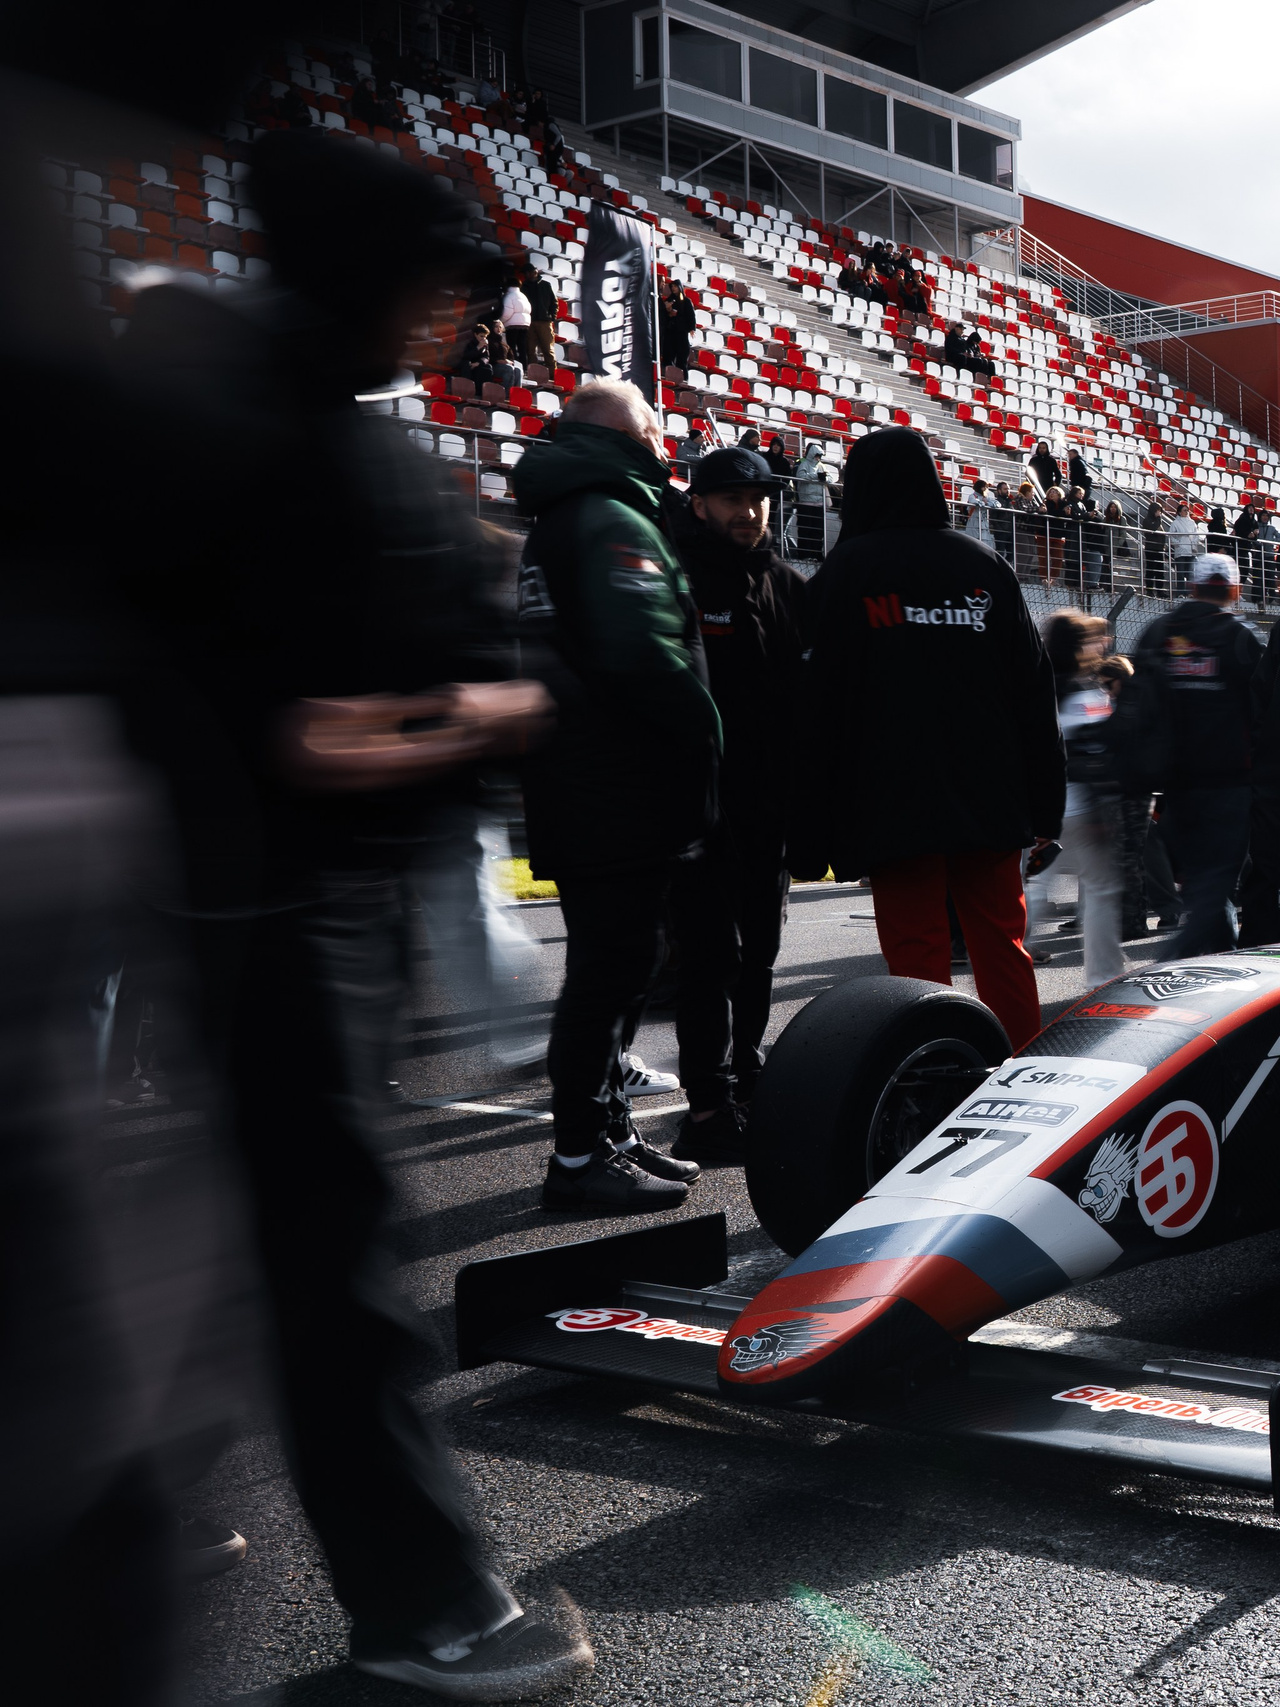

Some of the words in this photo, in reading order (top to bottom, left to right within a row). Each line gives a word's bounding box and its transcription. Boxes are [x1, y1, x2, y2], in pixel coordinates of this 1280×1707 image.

[967, 1102, 1067, 1121] AIMOL
[905, 1127, 1032, 1178] 77
[623, 1318, 728, 1344] Бирел
[1060, 1386, 1203, 1417] Бирель
